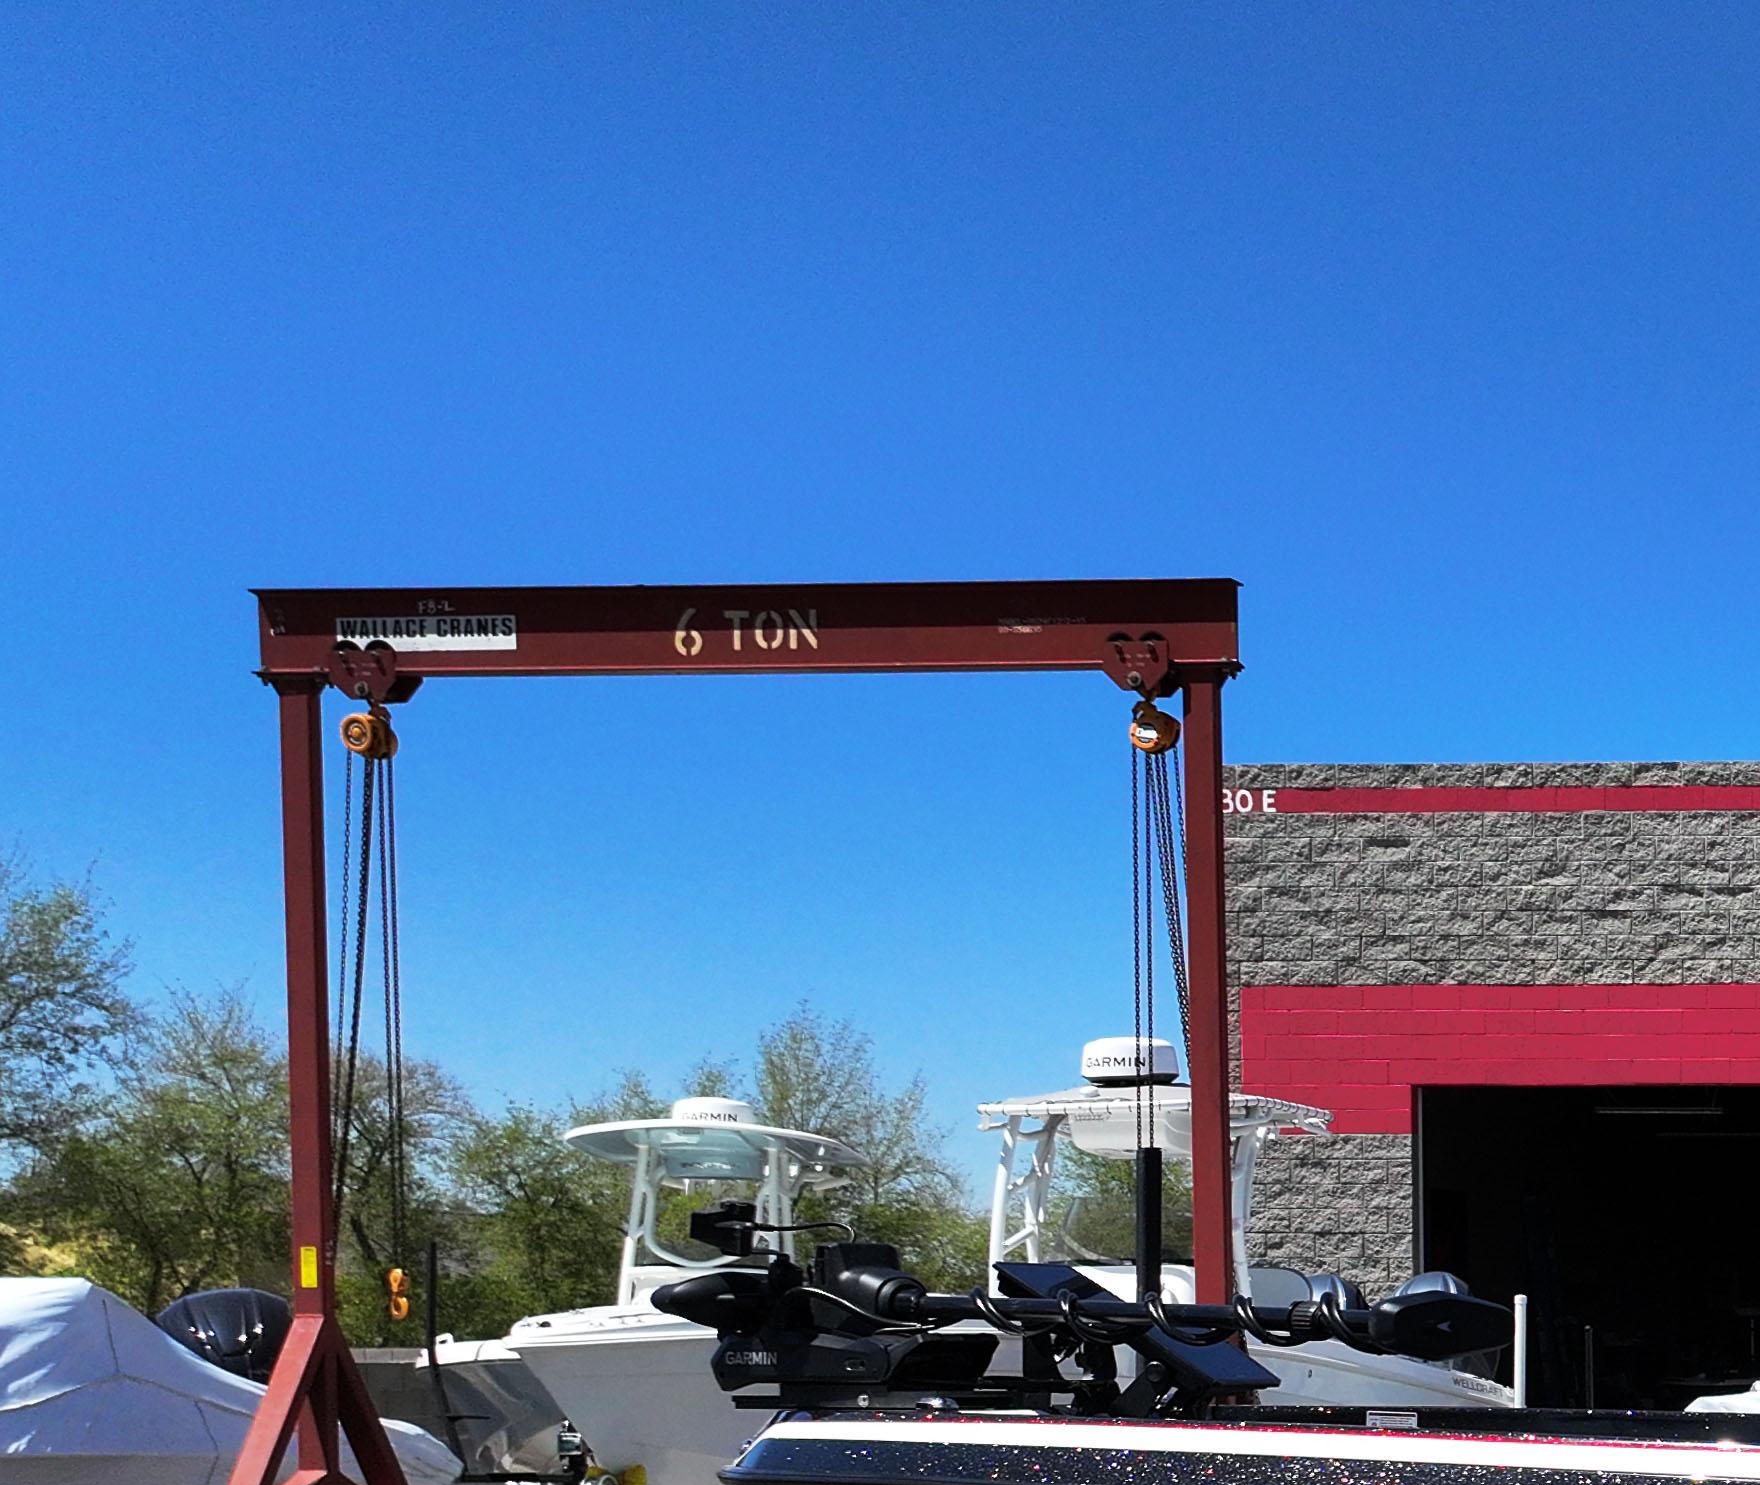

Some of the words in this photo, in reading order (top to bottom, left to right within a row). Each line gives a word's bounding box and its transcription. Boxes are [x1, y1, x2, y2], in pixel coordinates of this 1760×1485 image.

[340, 618, 428, 639] WALLACE
[437, 616, 515, 638] CRANES
[674, 607, 703, 657] 6
[723, 608, 818, 651] TON
[1262, 789, 1277, 813] E
[1086, 1056, 1146, 1068] GARMIN
[682, 1112, 738, 1122] GARMIN
[725, 1351, 778, 1366] GARMIN
